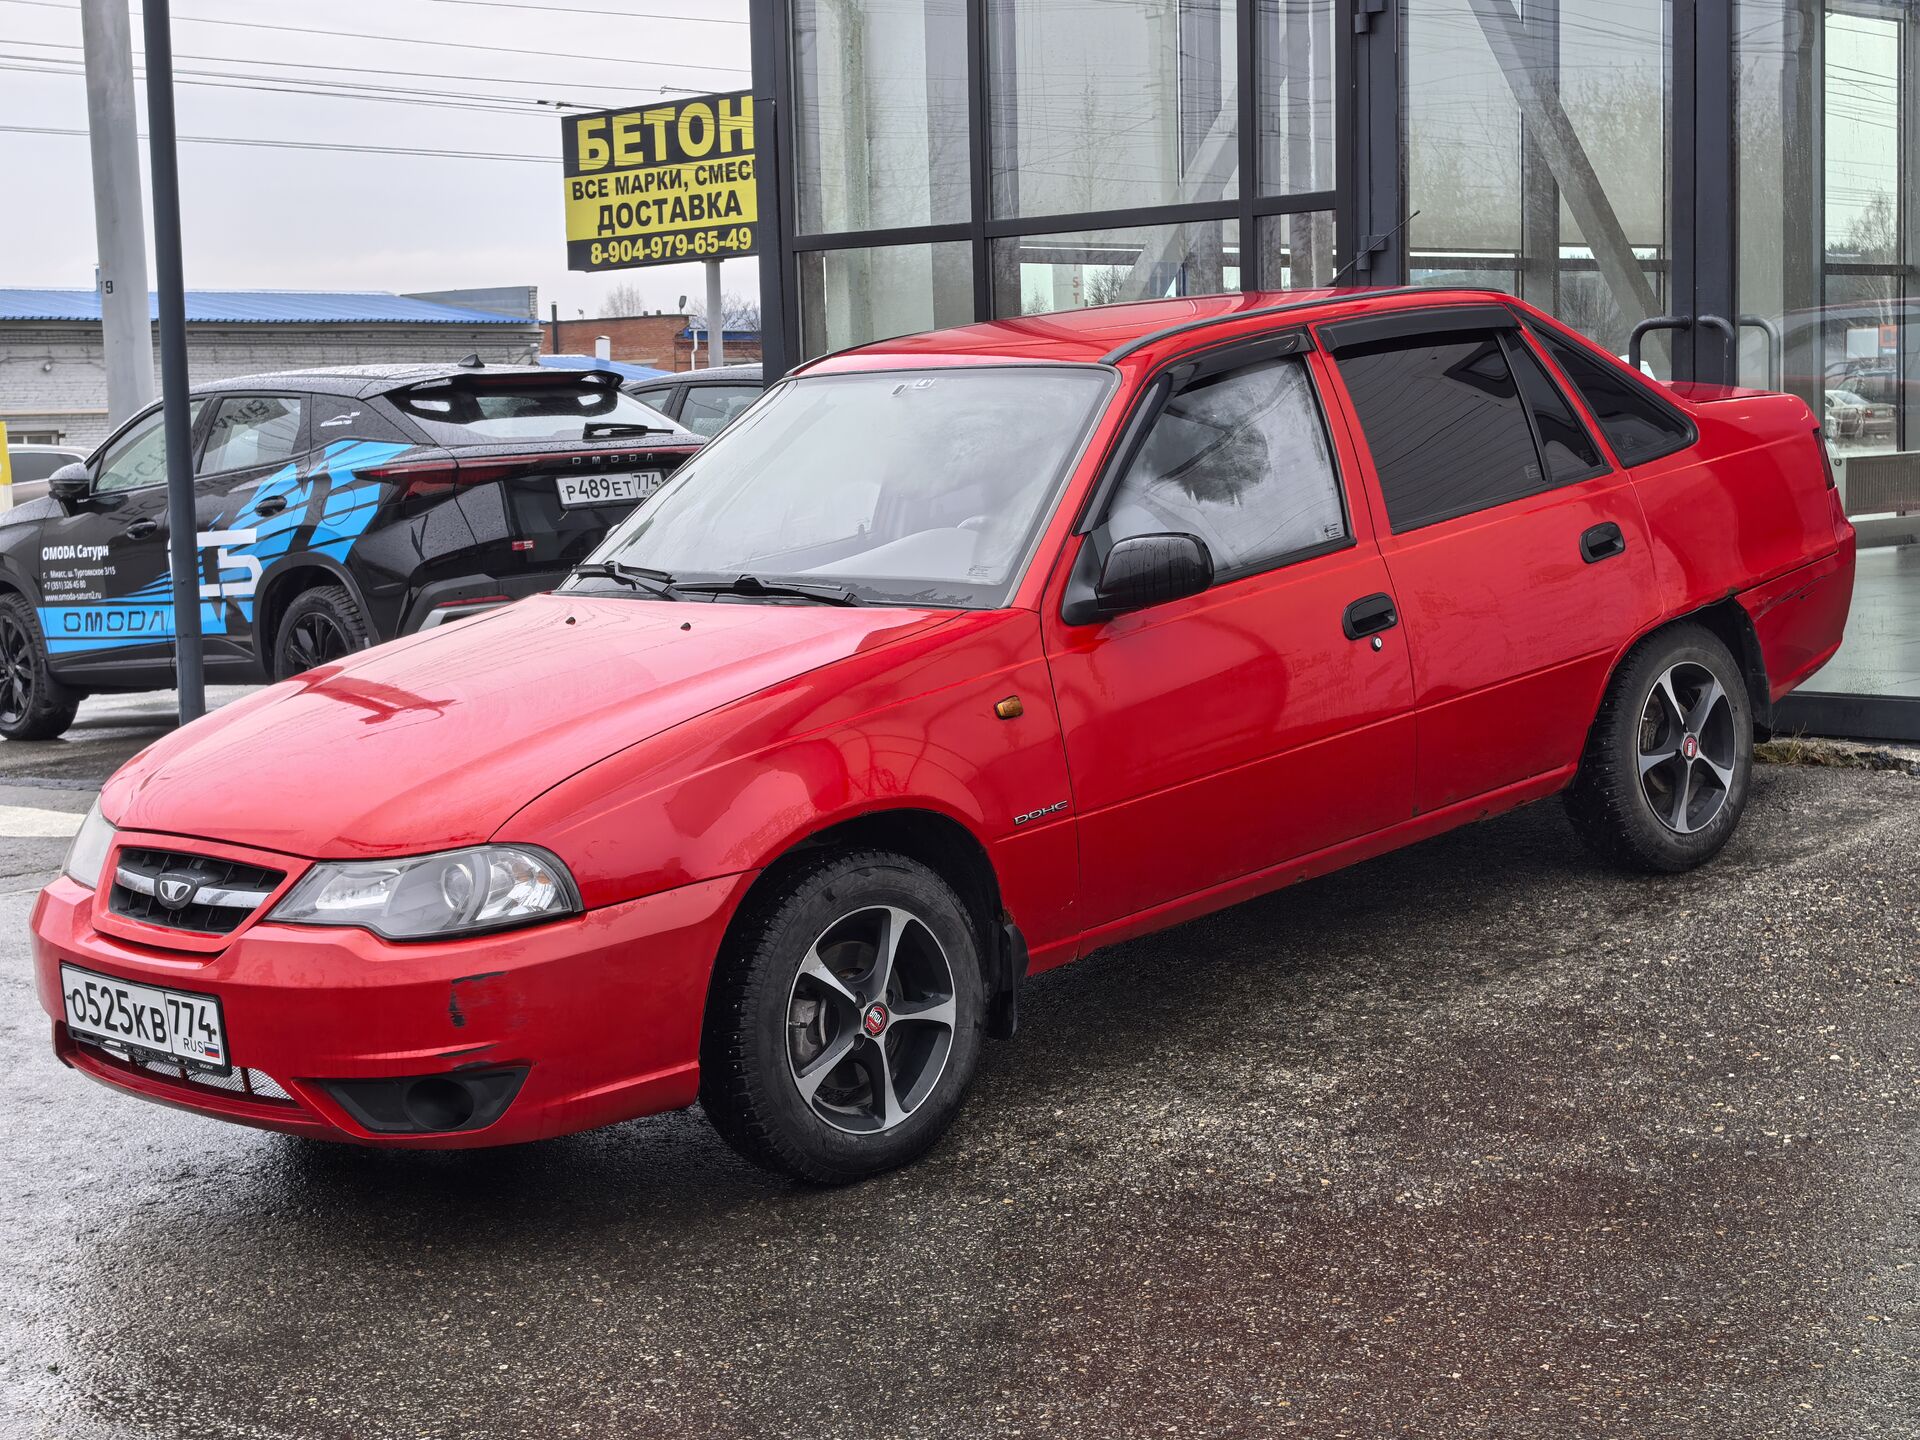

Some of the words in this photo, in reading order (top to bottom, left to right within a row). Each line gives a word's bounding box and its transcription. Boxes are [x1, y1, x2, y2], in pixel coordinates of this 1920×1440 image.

[577, 95, 755, 172] БЕТОН
[572, 178, 609, 201] ВСЕ
[615, 168, 688, 196] МАРКИ,
[597, 189, 743, 237] ДОСТАВКА
[590, 227, 752, 265] 8-904-979-65-49
[565, 478, 632, 501] Р489ЕТ
[633, 474, 660, 490] 774
[42, 546, 76, 561] OMODA
[76, 544, 109, 562] Сатурн
[51, 581, 64, 591] (351)
[63, 610, 165, 633] OMODA
[1014, 800, 1068, 825] DOHC
[72, 980, 167, 1043] О525КВ
[167, 998, 213, 1042] 774
[183, 1037, 204, 1054] RUS
